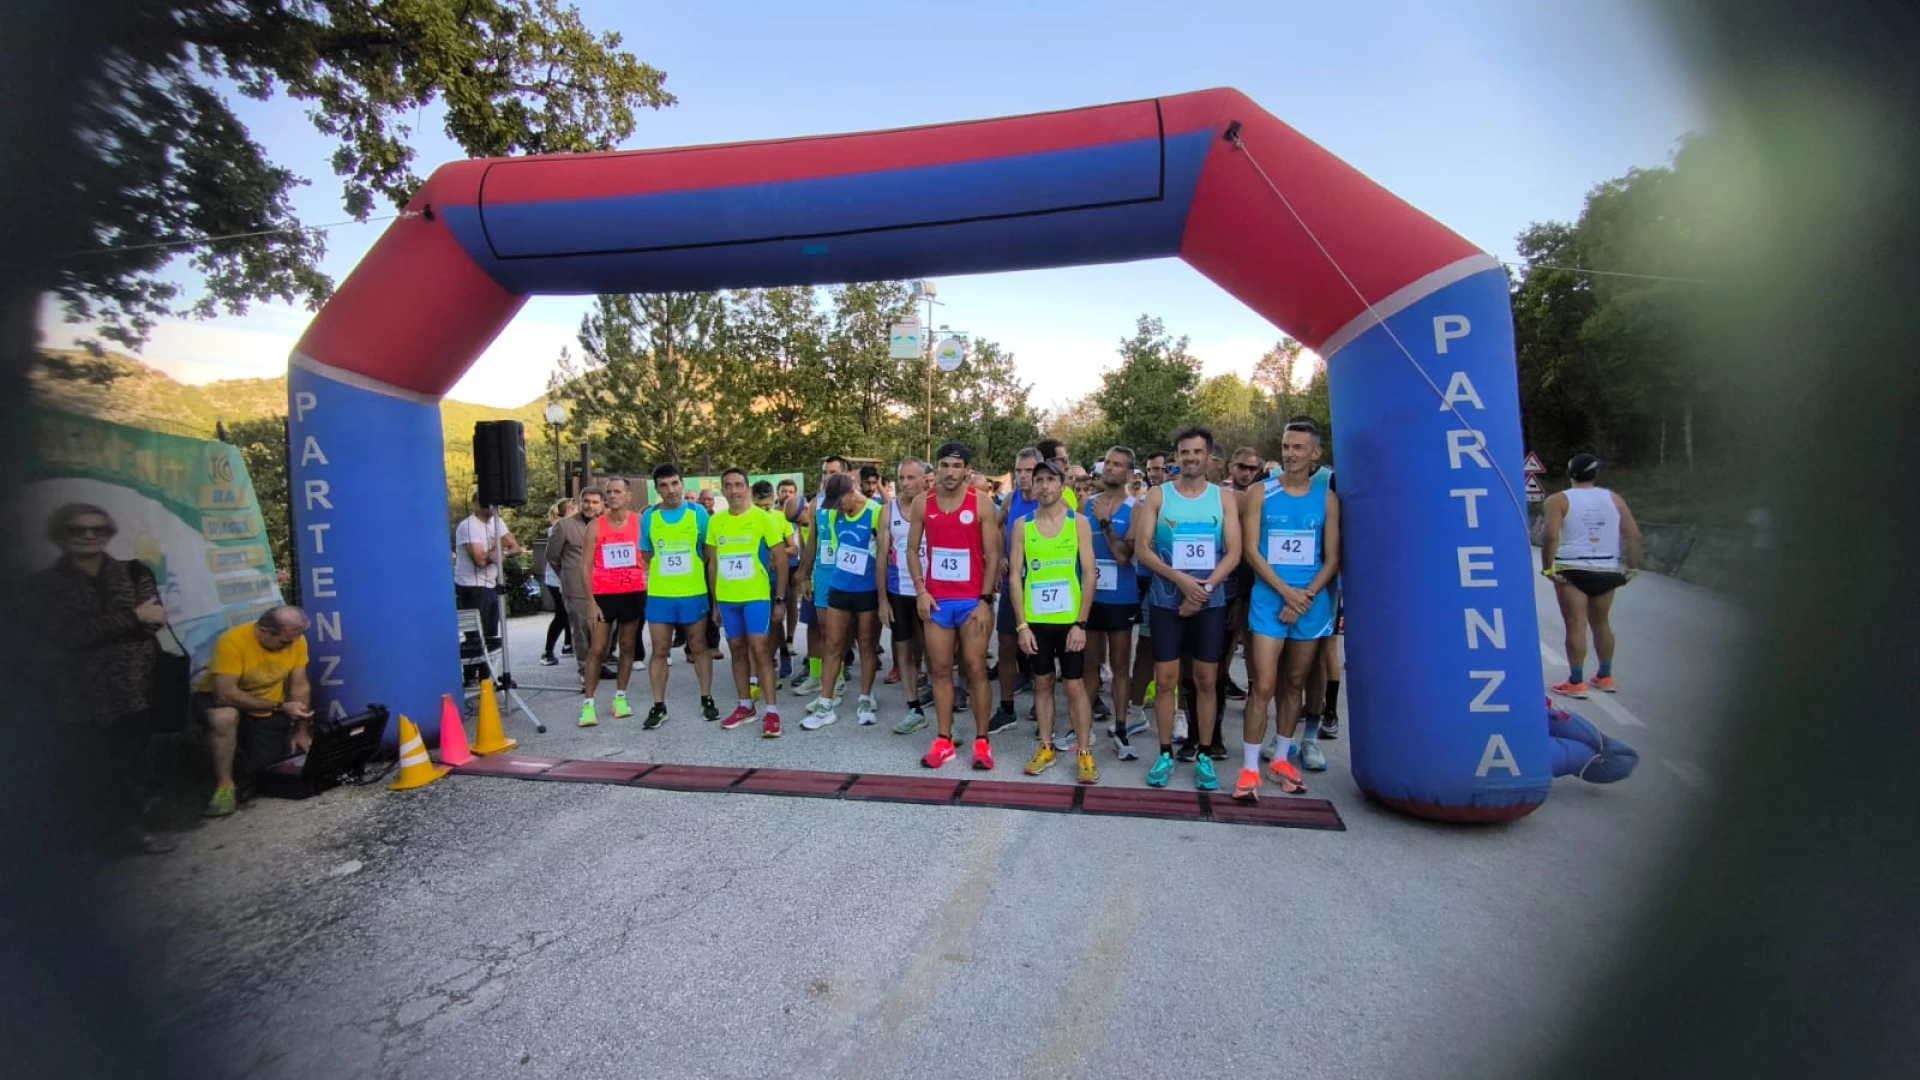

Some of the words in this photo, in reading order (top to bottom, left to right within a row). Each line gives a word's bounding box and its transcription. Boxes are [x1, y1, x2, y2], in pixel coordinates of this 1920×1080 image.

[1186, 544, 1205, 558] 36
[1281, 539, 1302, 553] 42
[1433, 315, 1521, 777] PARTENZA
[295, 391, 348, 721] PARTENZA
[610, 548, 630, 560] 110
[843, 552, 857, 565] 20
[667, 556, 682, 567] 53
[728, 560, 743, 571] 74
[941, 558, 958, 571] 43
[1041, 589, 1059, 602] 57
